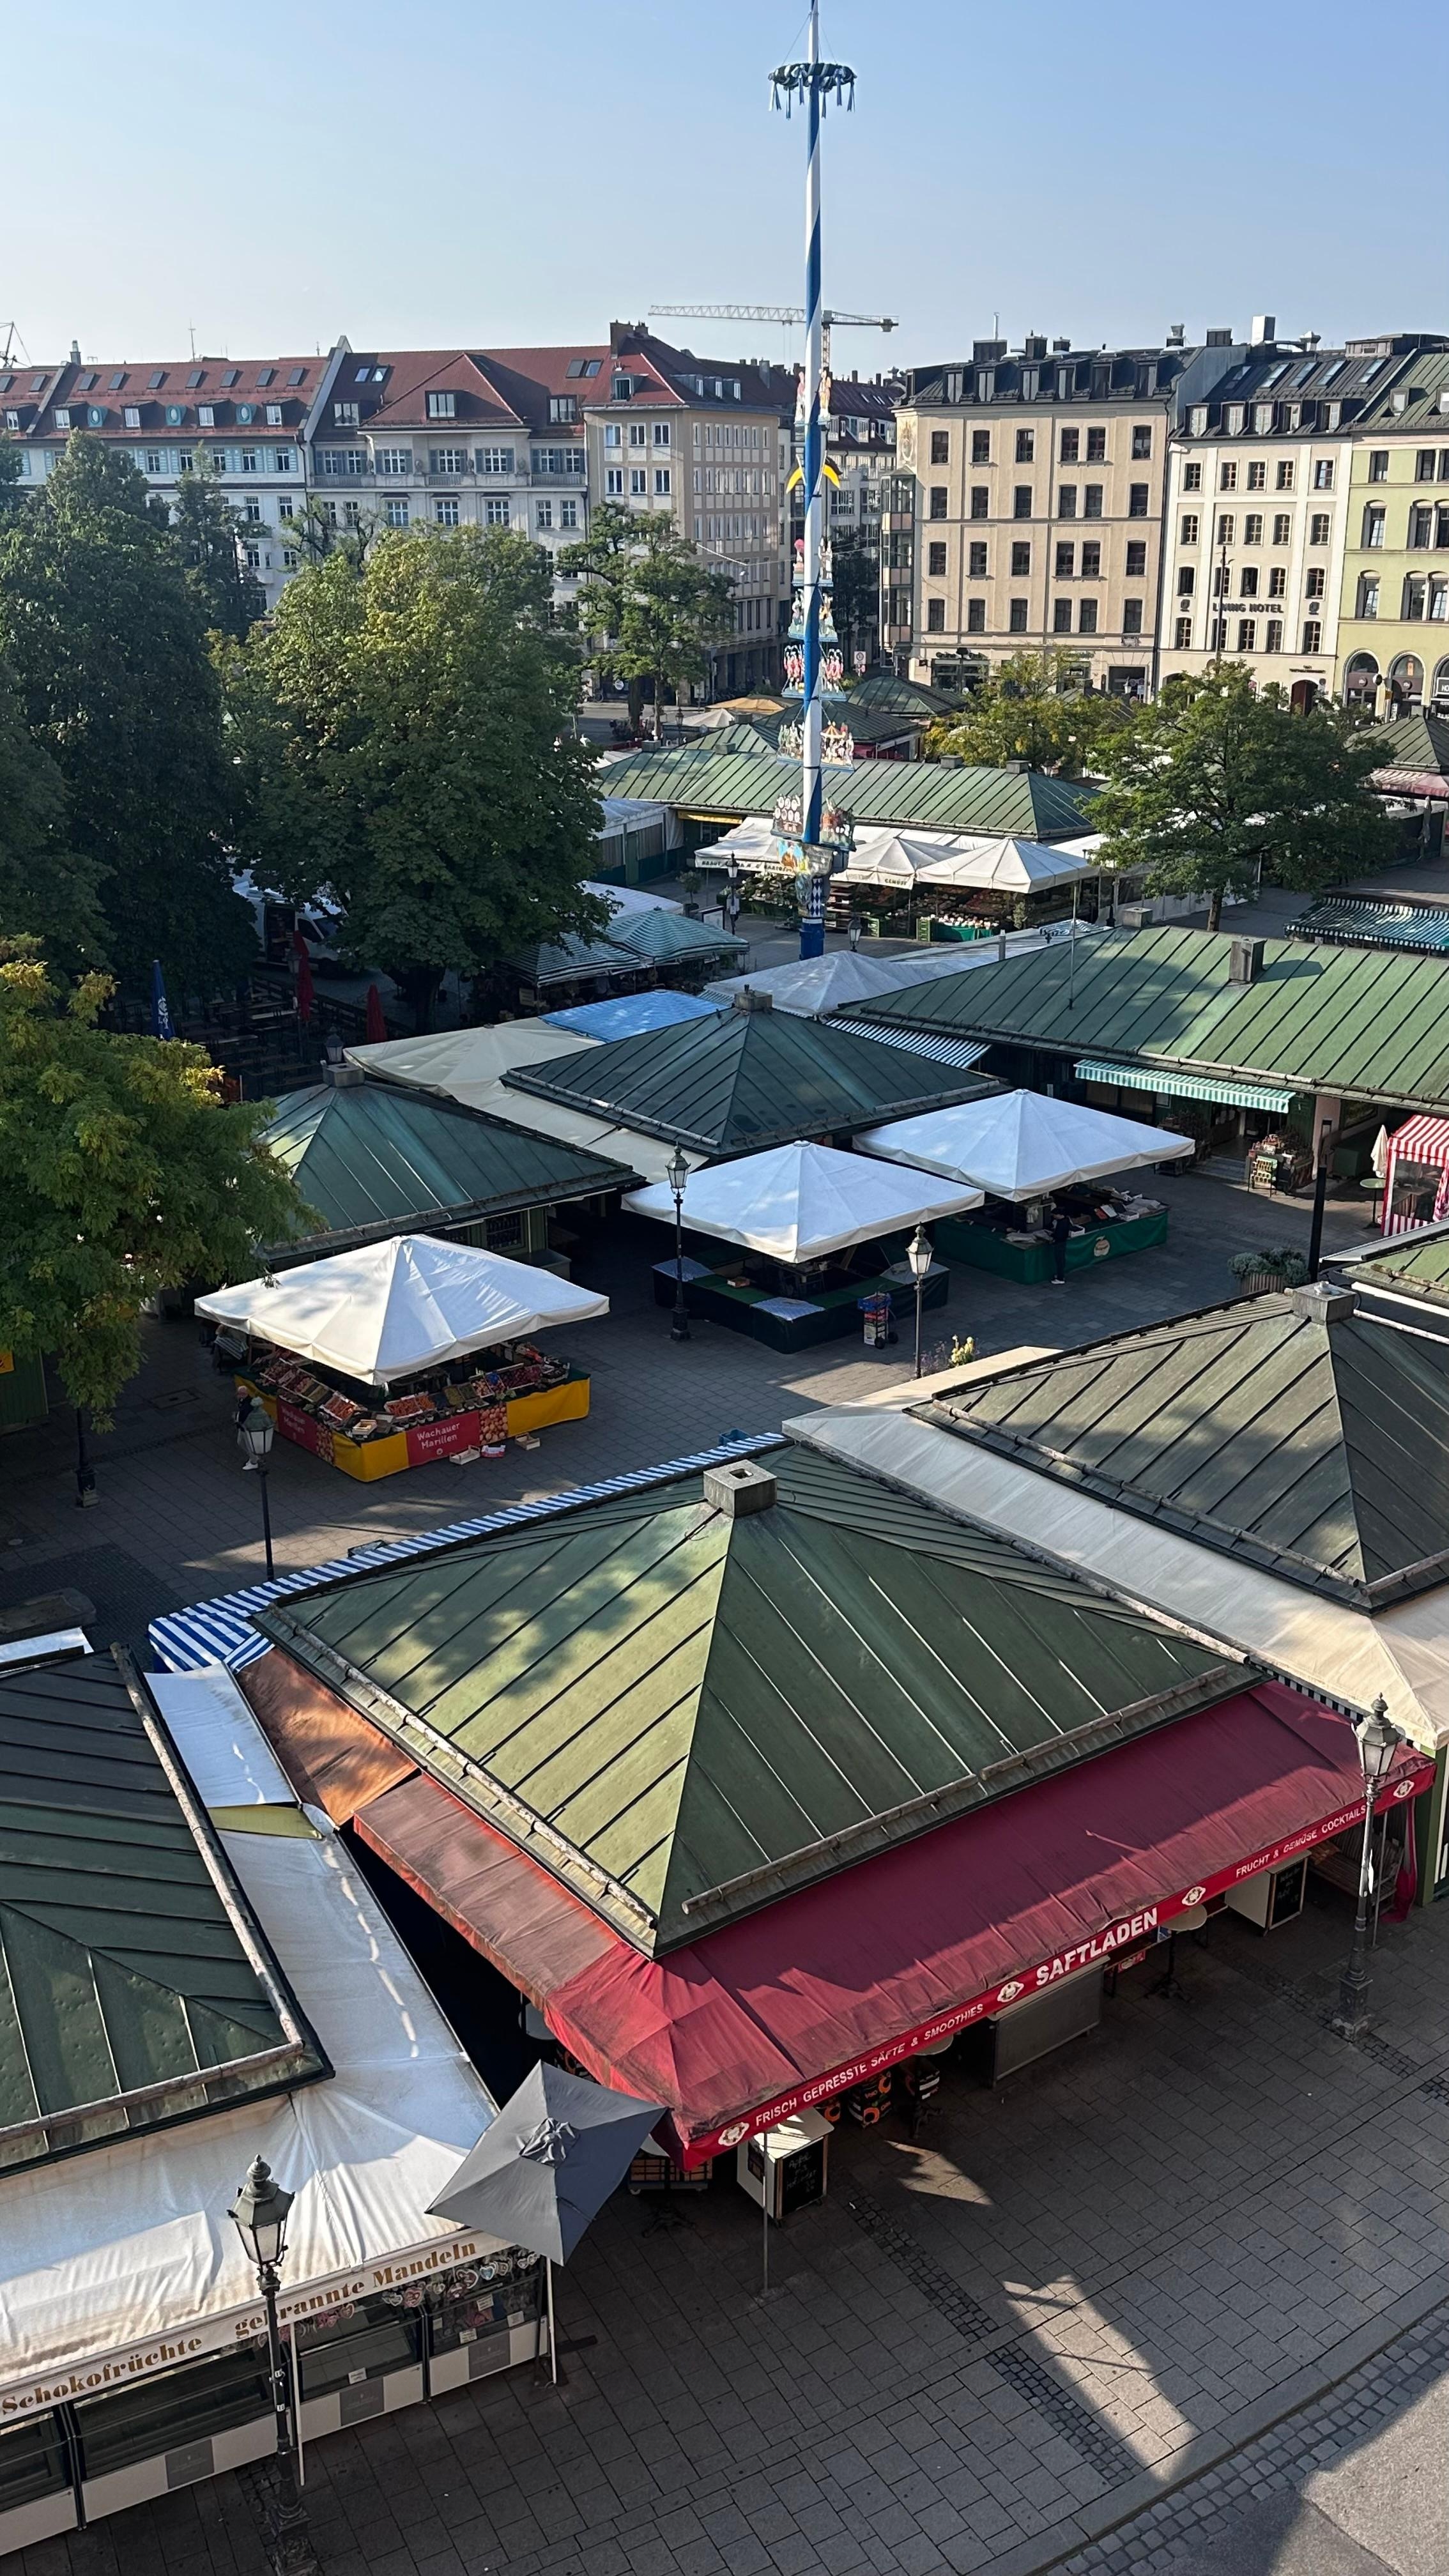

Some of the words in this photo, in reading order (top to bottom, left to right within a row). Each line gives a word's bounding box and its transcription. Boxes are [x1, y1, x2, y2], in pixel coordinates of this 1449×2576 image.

[1213, 602, 1246, 612] LVING
[1249, 604, 1284, 613] HOTEL
[417, 1423, 460, 1441] Wachauer
[421, 1434, 457, 1450] Marillen
[755, 2097, 797, 2126] FRISCH
[802, 2062, 868, 2103] GEPRESSTE
[871, 2043, 905, 2067] SÄFTE
[910, 2037, 919, 2047] &
[924, 2004, 984, 2040] SMOOTHIES
[1036, 1907, 1158, 1986] SAFTLADEN
[1236, 1853, 1270, 1878] FRUCHT
[1273, 1849, 1279, 1859] &
[1283, 1828, 1317, 1853] GEMÜSE
[1321, 1805, 1366, 1834] COCKTAILS
[2, 2338, 203, 2416] Schokofrüchte
[372, 2242, 476, 2288] Mandeln
